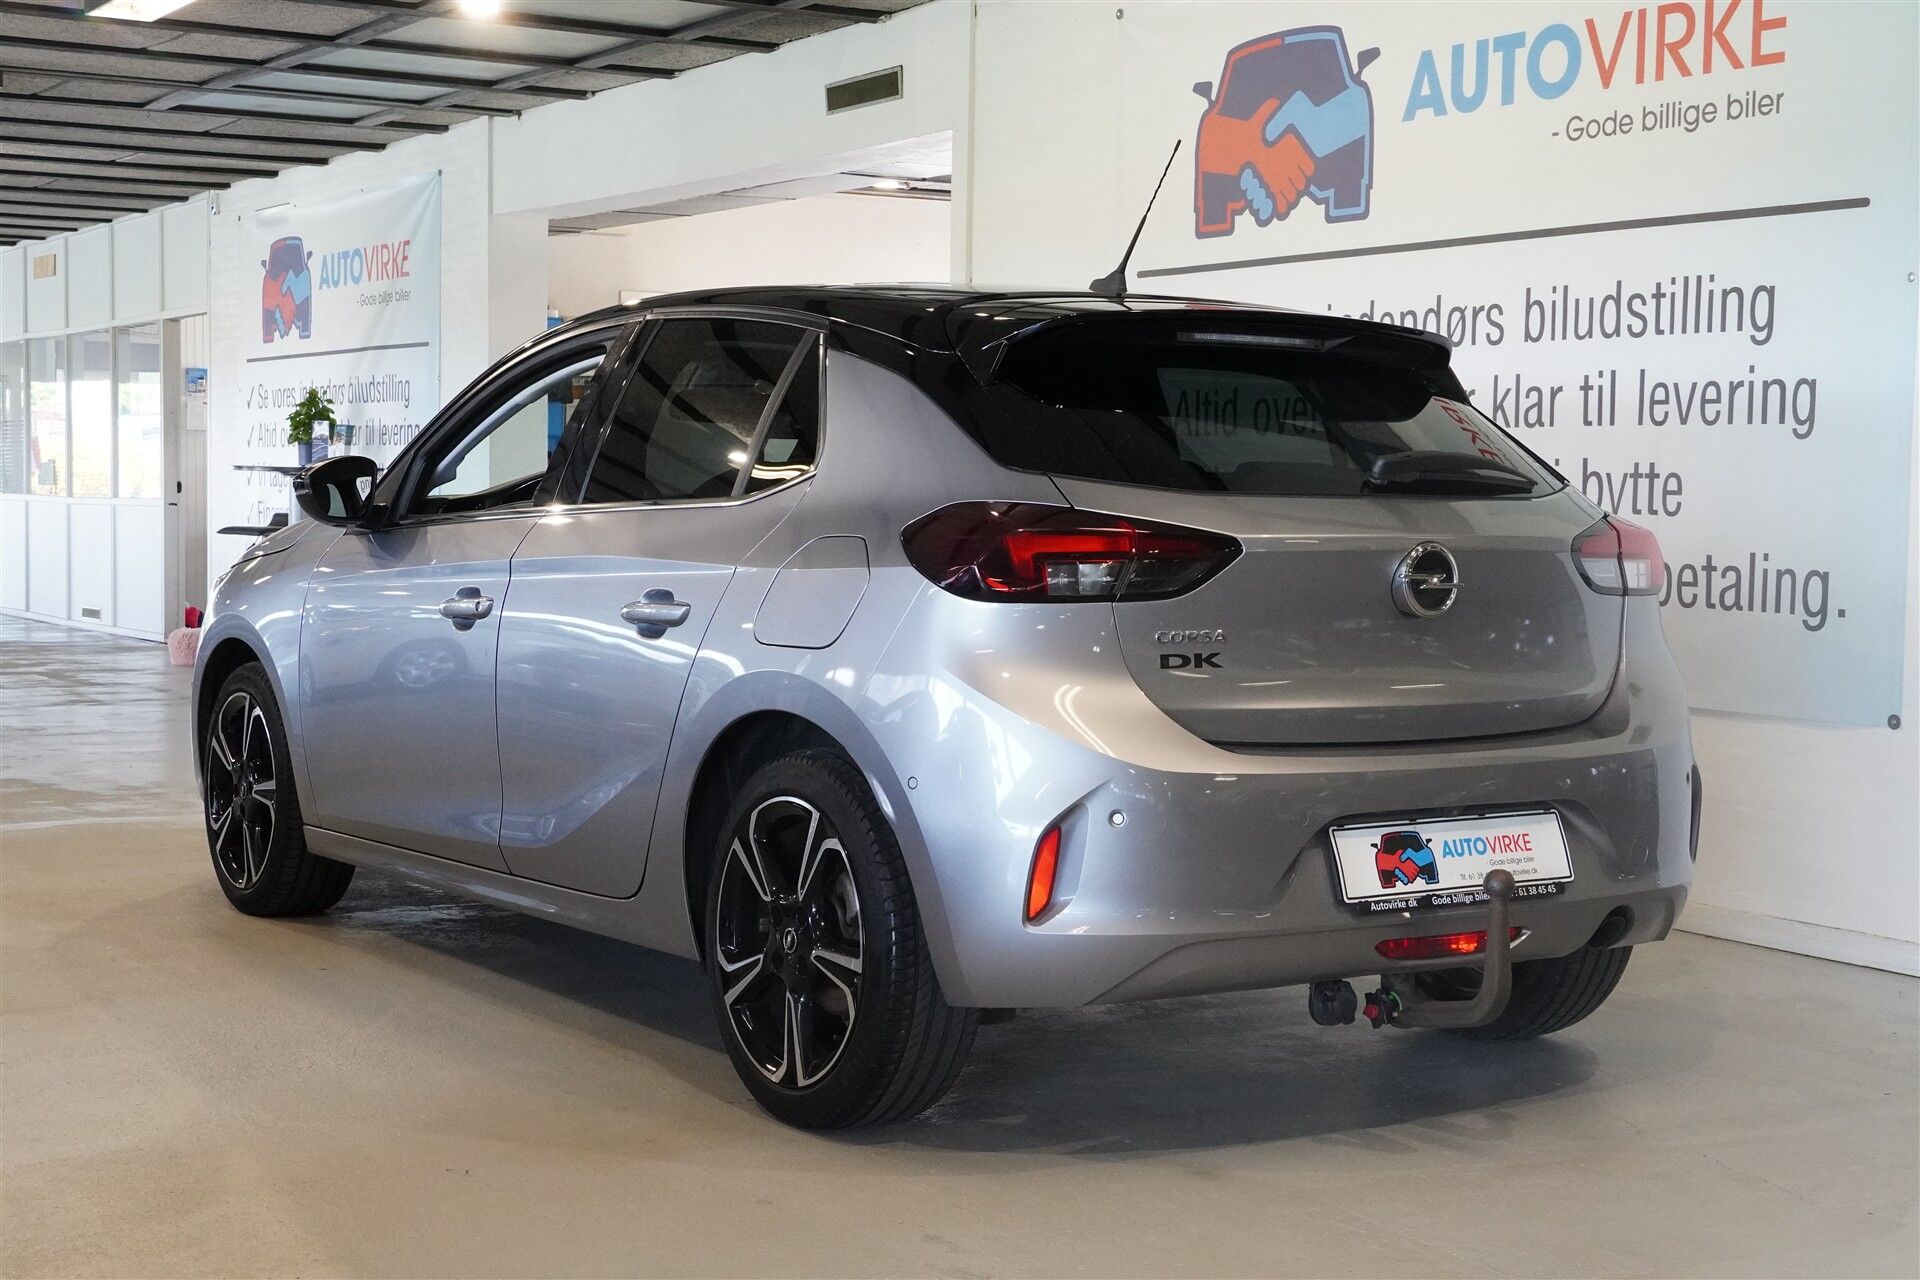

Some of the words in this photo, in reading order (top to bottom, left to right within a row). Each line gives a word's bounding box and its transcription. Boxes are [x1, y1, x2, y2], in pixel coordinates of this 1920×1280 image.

[1401, 0, 1787, 122] AUTOVIRKE
[1565, 110, 1633, 141] Gode
[1642, 97, 1717, 133] billige
[1726, 90, 1784, 121] biler
[319, 239, 411, 290] AUTOVIRKE
[1523, 275, 1777, 346] biludstilling
[258, 383, 269, 409] Se
[271, 386, 297, 409] vores
[348, 373, 411, 408] biludstilling
[1175, 386, 1239, 436] Altid
[1491, 373, 1564, 429] klar
[1579, 369, 1617, 427] til
[1637, 365, 1818, 440] levering
[257, 421, 277, 449] Altid
[365, 418, 375, 446] til
[1581, 457, 1683, 517] bytte
[1155, 629, 1224, 643] CORSA
[1160, 652, 1224, 670] DK
[1442, 833, 1533, 859] AUTOVIRKE
[1370, 899, 1406, 911] Autovirke
[1431, 894, 1452, 906] Gode
[1452, 891, 1474, 904] billige
[1518, 887, 1527, 897] 61
[1528, 886, 1538, 896] 38
[1538, 884, 1547, 894] 45
[1547, 883, 1557, 893] 45
